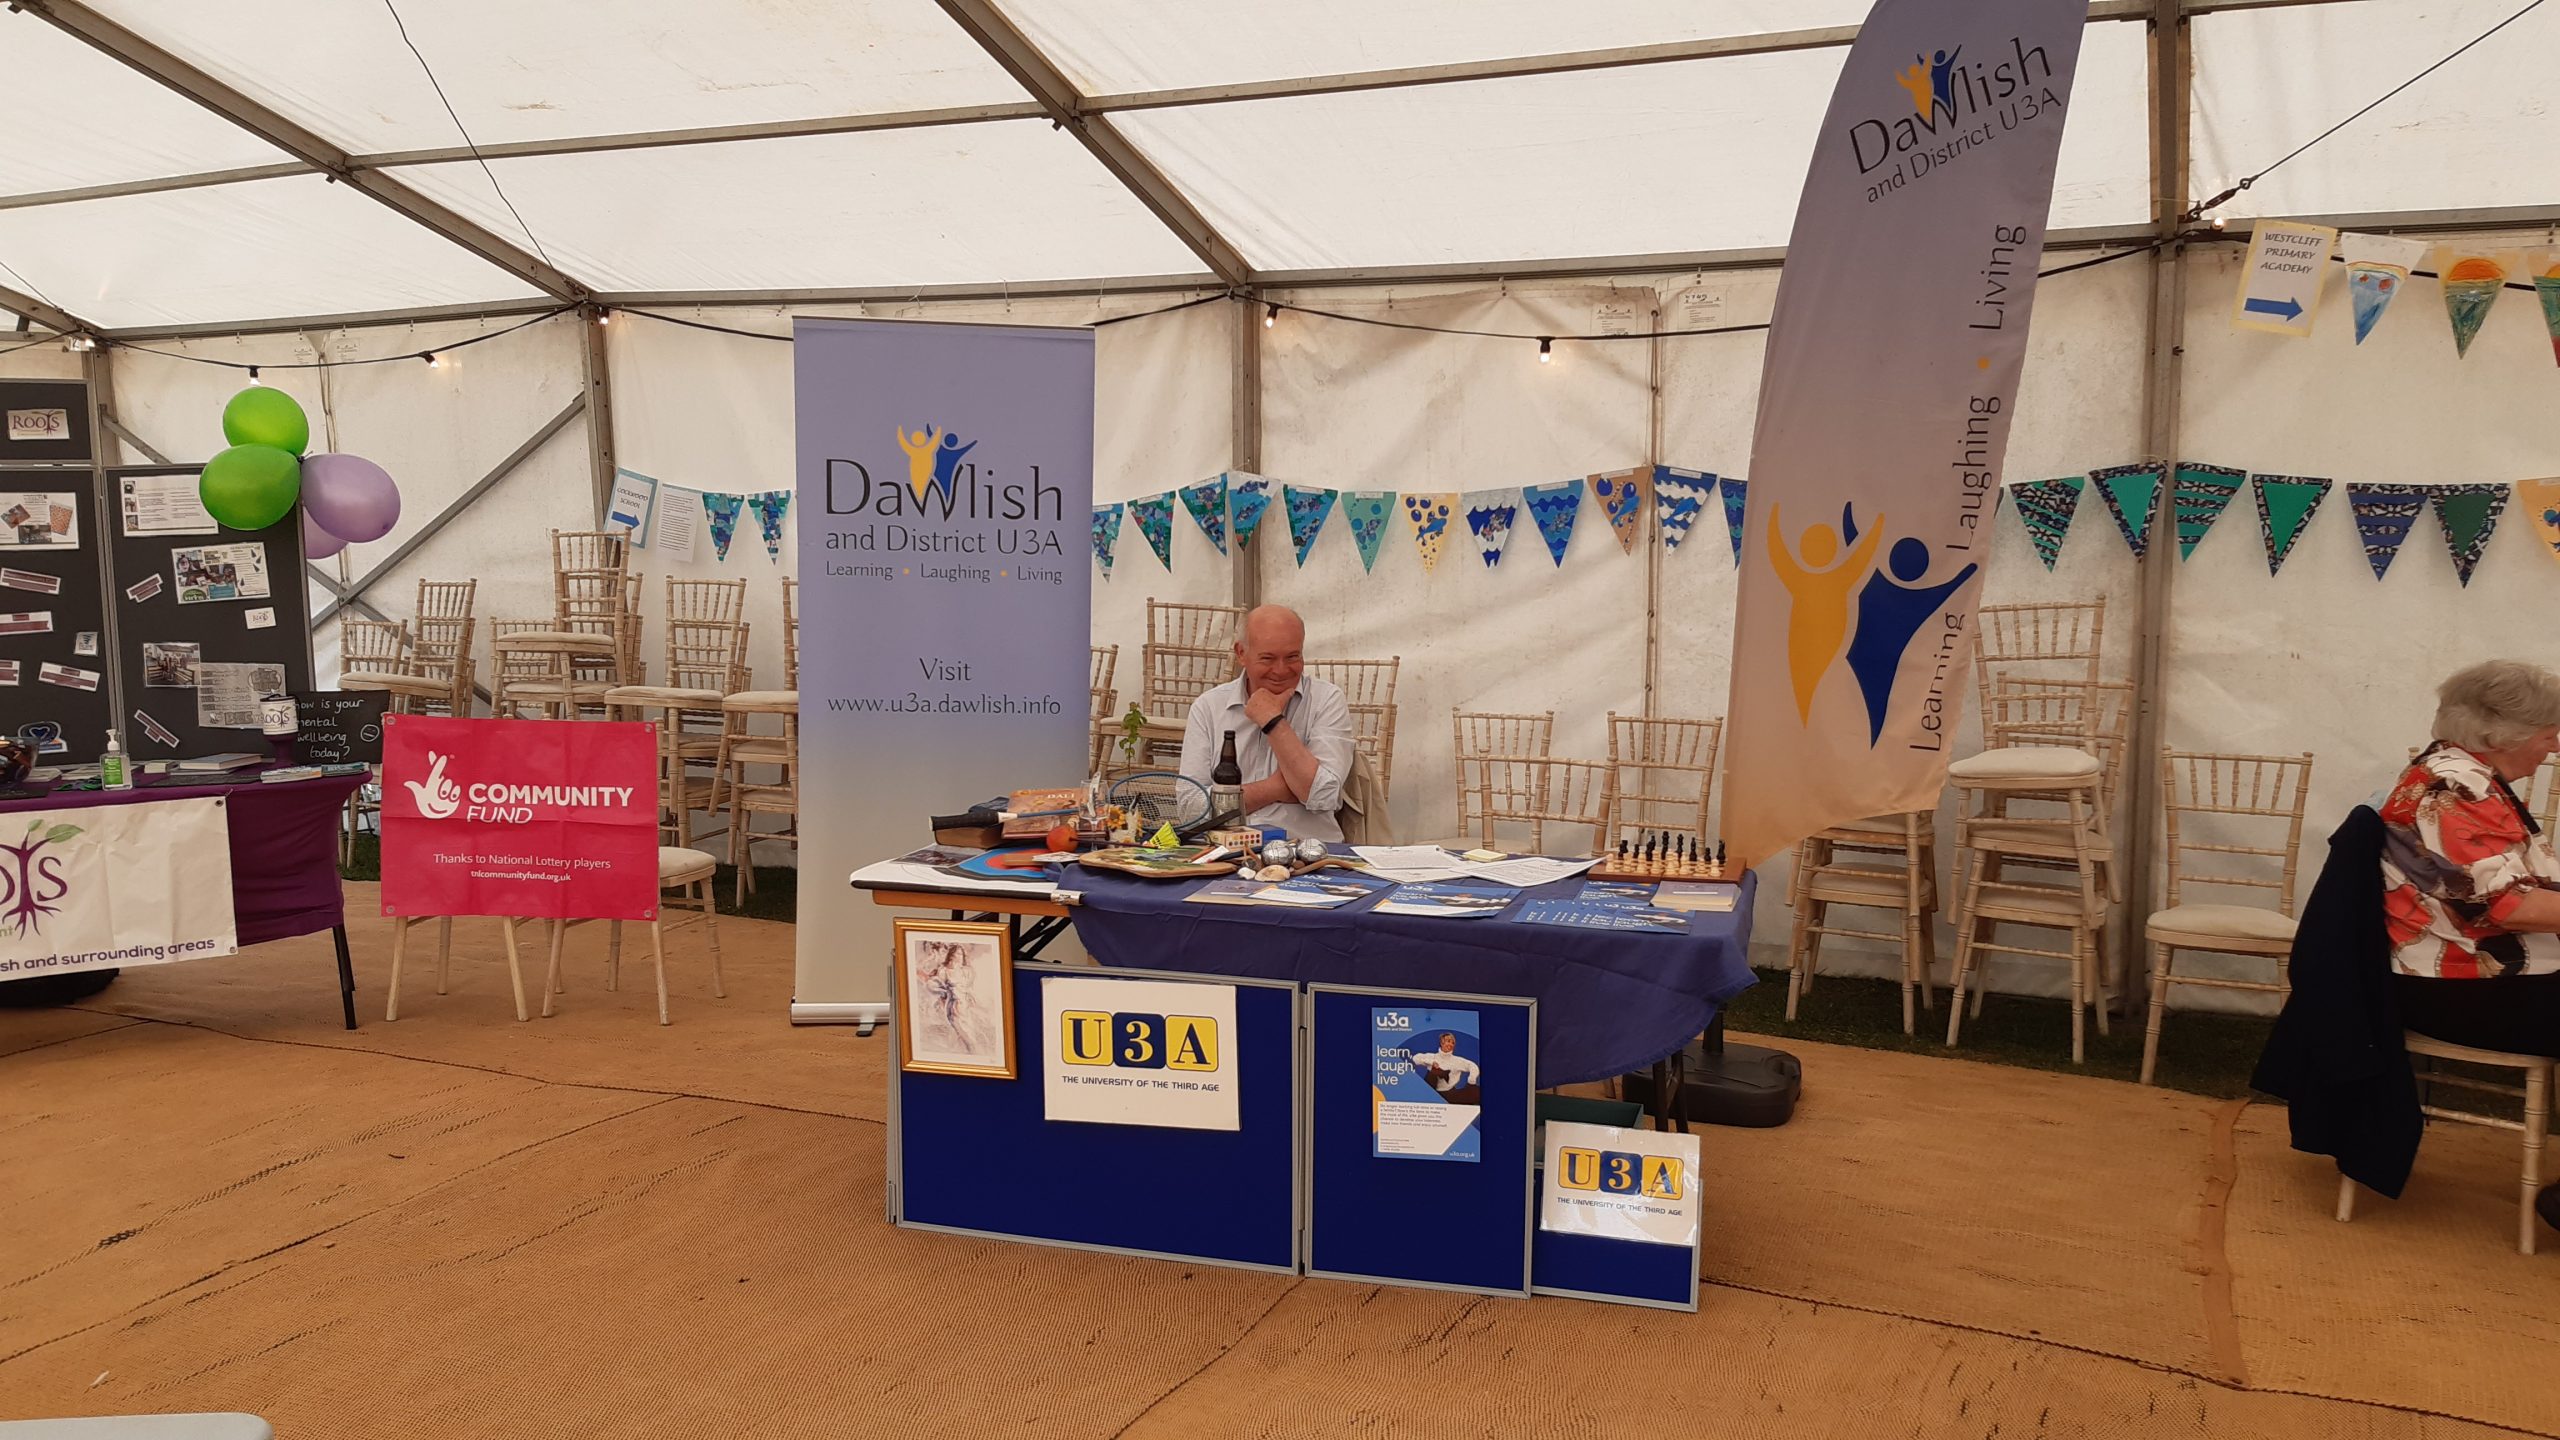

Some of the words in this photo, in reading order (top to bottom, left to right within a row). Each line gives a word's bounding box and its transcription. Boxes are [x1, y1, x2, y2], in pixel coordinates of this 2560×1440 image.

[1850, 37, 2051, 175] Dawlish
[1867, 164, 1906, 203] and
[1910, 122, 1996, 179] District
[2000, 87, 2061, 131] U3A
[2264, 232, 2324, 247] WESTCLIFF
[2264, 247, 2316, 260] PRIMARY
[1969, 224, 2027, 330] Living
[2260, 262, 2313, 274] ACADEMY
[1946, 395, 2001, 550] Laughing
[825, 458, 1063, 522] Dawlish
[826, 525, 875, 551] and
[887, 525, 986, 554] District
[997, 528, 1063, 556] U3A
[826, 561, 894, 581] Learning
[920, 563, 991, 584] Laughing
[1017, 565, 1063, 585] Living
[919, 657, 972, 681] Visit
[1910, 612, 1966, 751] Learning
[321, 699, 331, 709] is
[335, 700, 365, 714] your
[827, 692, 1062, 715] www.u3a.dawlish.info
[468, 783, 634, 807] COMMUNITY
[466, 805, 533, 824] FUND
[433, 853, 473, 864] Thanks
[475, 854, 486, 864] to
[489, 854, 533, 866] National
[535, 855, 571, 869] Lottery
[574, 858, 611, 870] players
[471, 869, 571, 883] tnlcommunityfund.org.uk
[24, 954, 57, 969] and
[61, 944, 165, 965] surrounding
[168, 939, 215, 955] areas
[1377, 1012, 1409, 1027] u3a
[1067, 1017, 1212, 1066] U3A
[1377, 1045, 1412, 1060] learn,
[1377, 1059, 1416, 1075] laugh,
[1062, 1076, 1079, 1084] THE
[1082, 1077, 1134, 1087] UNIVERSITY
[1136, 1079, 1149, 1088] OF
[1152, 1080, 1169, 1089] THE
[1172, 1082, 1199, 1091] THIRD
[1201, 1083, 1220, 1092] AGE
[1377, 1073, 1399, 1085] live
[1565, 1151, 1678, 1195] U3A
[1557, 1196, 1571, 1204] THE
[1572, 1198, 1615, 1209] UNIVERSITY
[1628, 1204, 1642, 1212] THE
[1644, 1206, 1666, 1215] THIRD
[1668, 1209, 1682, 1217] AGE
